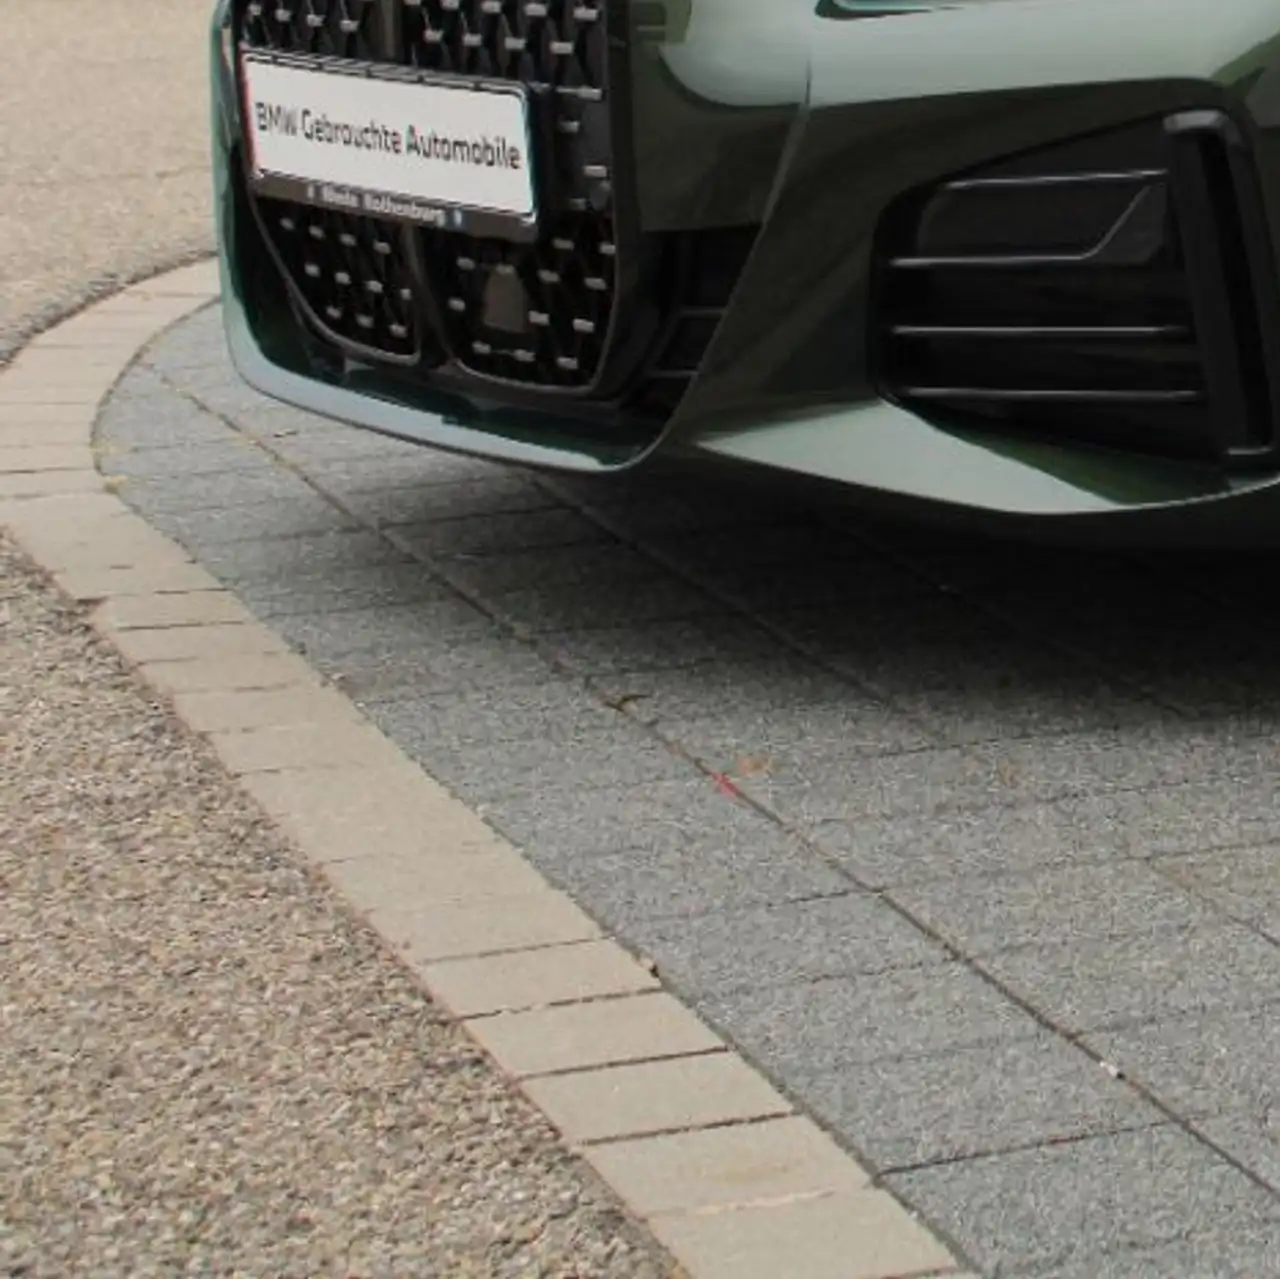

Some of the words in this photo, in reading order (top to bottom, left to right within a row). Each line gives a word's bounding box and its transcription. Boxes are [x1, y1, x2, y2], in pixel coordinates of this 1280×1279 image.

[255, 101, 298, 137] BMW
[301, 108, 402, 155] Gebrauchte
[406, 124, 521, 170] Automobile
